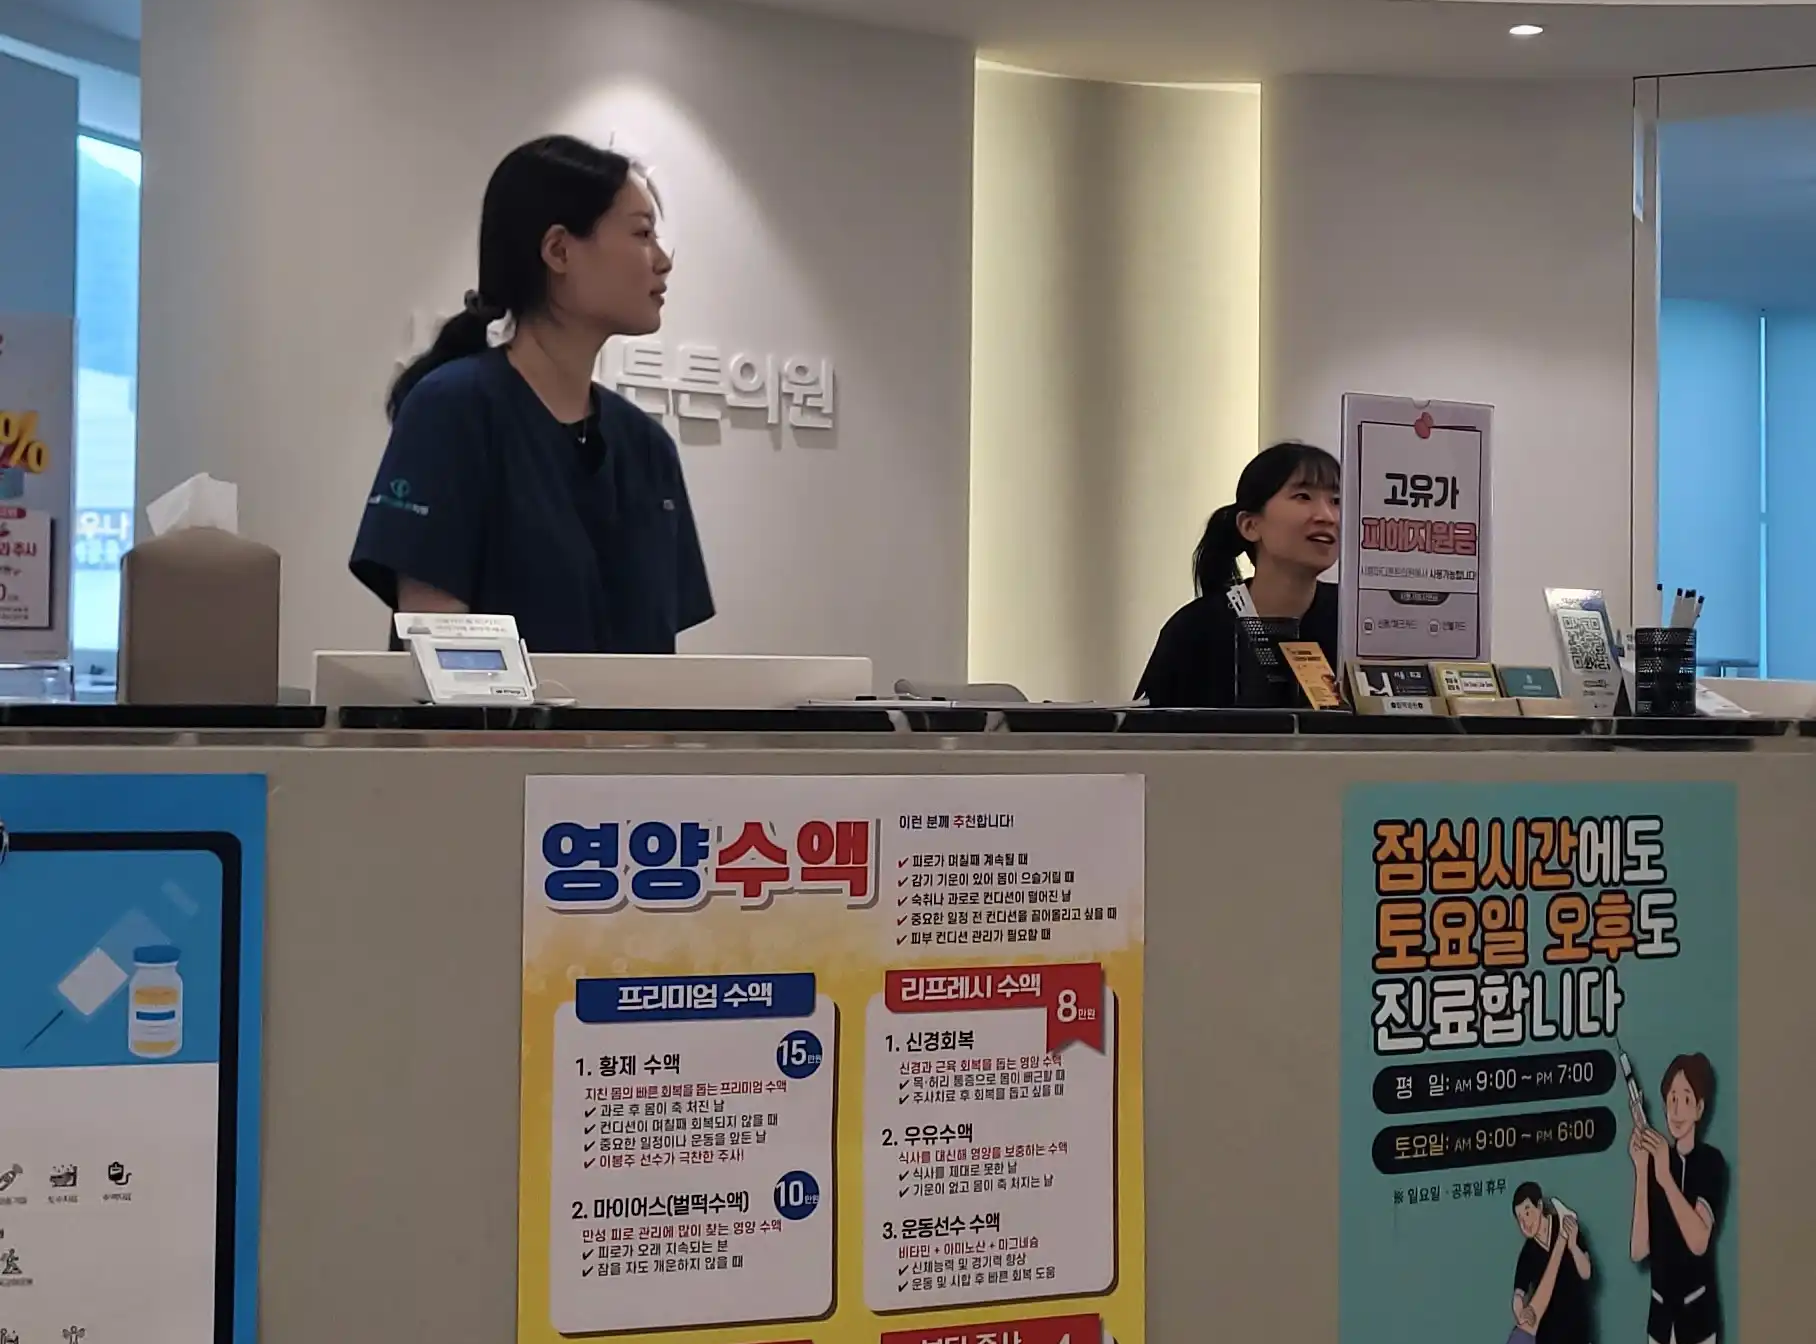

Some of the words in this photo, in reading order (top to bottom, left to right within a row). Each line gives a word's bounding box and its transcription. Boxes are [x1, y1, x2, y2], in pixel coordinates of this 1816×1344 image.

[601, 339, 833, 429] 튼튼의원
[1384, 472, 1459, 509] 고유가
[1362, 517, 1477, 556] 피해지원금
[899, 815, 922, 829] 이런
[926, 815, 949, 829] 분께
[953, 814, 1014, 828] 추천합니다!
[542, 821, 869, 901] 영양수액
[1373, 815, 1666, 894] 점심시간에도
[912, 874, 933, 887] 감기
[937, 873, 969, 886] 기운이
[973, 872, 993, 885] 있어
[998, 872, 1018, 885] 몸이
[1065, 872, 1074, 883] 때
[912, 893, 944, 906] 숙취나
[948, 892, 980, 905] 과로로
[984, 891, 1025, 904] 컨디션이
[1062, 890, 1071, 902] 날
[911, 931, 932, 944] 피부
[936, 931, 968, 944] 컨디션
[972, 930, 1003, 943] 관리가
[1007, 929, 1038, 942] 필요할
[1042, 928, 1050, 940] 때
[1372, 892, 1530, 974] 토요일
[1543, 887, 1680, 964] 오후도
[617, 984, 717, 1011] 프리미엄
[724, 982, 772, 1007] 수액
[901, 975, 991, 1001] 리프레시
[997, 974, 1040, 997] 수액
[1371, 965, 1624, 1056] 진료합니다
[886, 1035, 900, 1052] 1.
[906, 1030, 974, 1052] 신경회복
[576, 1058, 592, 1076] 1.
[599, 1055, 636, 1076] 황제
[644, 1054, 680, 1075] 수액
[585, 1089, 607, 1101] 지친
[611, 1087, 633, 1100] 몸의
[637, 1086, 658, 1099] 빠른
[662, 1085, 693, 1098] 회복을
[721, 1081, 762, 1095] 프리미엄
[766, 1080, 786, 1093] 수액
[1396, 1076, 1412, 1100] 평
[1429, 1073, 1450, 1096] 일:
[1455, 1077, 1471, 1092] AM
[1476, 1069, 1516, 1091] 9:00
[1536, 1072, 1552, 1085] PM
[1557, 1062, 1593, 1083] 7:00
[600, 1137, 636, 1151] 중요한
[641, 1135, 686, 1149] 일정이나
[691, 1134, 725, 1147] 운동을
[756, 1131, 766, 1144] 날
[882, 1129, 898, 1146] 2.
[904, 1124, 973, 1145] 우유수액
[1394, 1133, 1449, 1159] 토요일:
[1455, 1137, 1471, 1152] AM
[1476, 1128, 1516, 1150] 9:00
[1536, 1130, 1552, 1143] PM
[1557, 1119, 1594, 1141] 6:00
[600, 1155, 635, 1169] 이봉주
[640, 1153, 675, 1167] 선수가
[679, 1150, 713, 1164] 극찬한
[718, 1148, 744, 1162] 주사!
[1452, 1181, 1482, 1200] 공휴일
[1486, 1178, 1506, 1196] 휴무
[572, 1202, 588, 1219] 2.
[594, 1191, 749, 1219] 마이어스(벌떡수액)
[583, 1229, 606, 1243] 만성
[611, 1228, 634, 1240] 피로
[639, 1226, 673, 1240] 관리에
[679, 1224, 700, 1238] 많이
[734, 1221, 755, 1234] 영양
[760, 1219, 781, 1233] 수액
[882, 1222, 897, 1239] 3.
[902, 1216, 965, 1239] 운동선수
[970, 1212, 1000, 1234] 수액
[599, 1245, 634, 1259] 피로가
[638, 1244, 661, 1257] 오래
[666, 1241, 712, 1255] 지속되는
